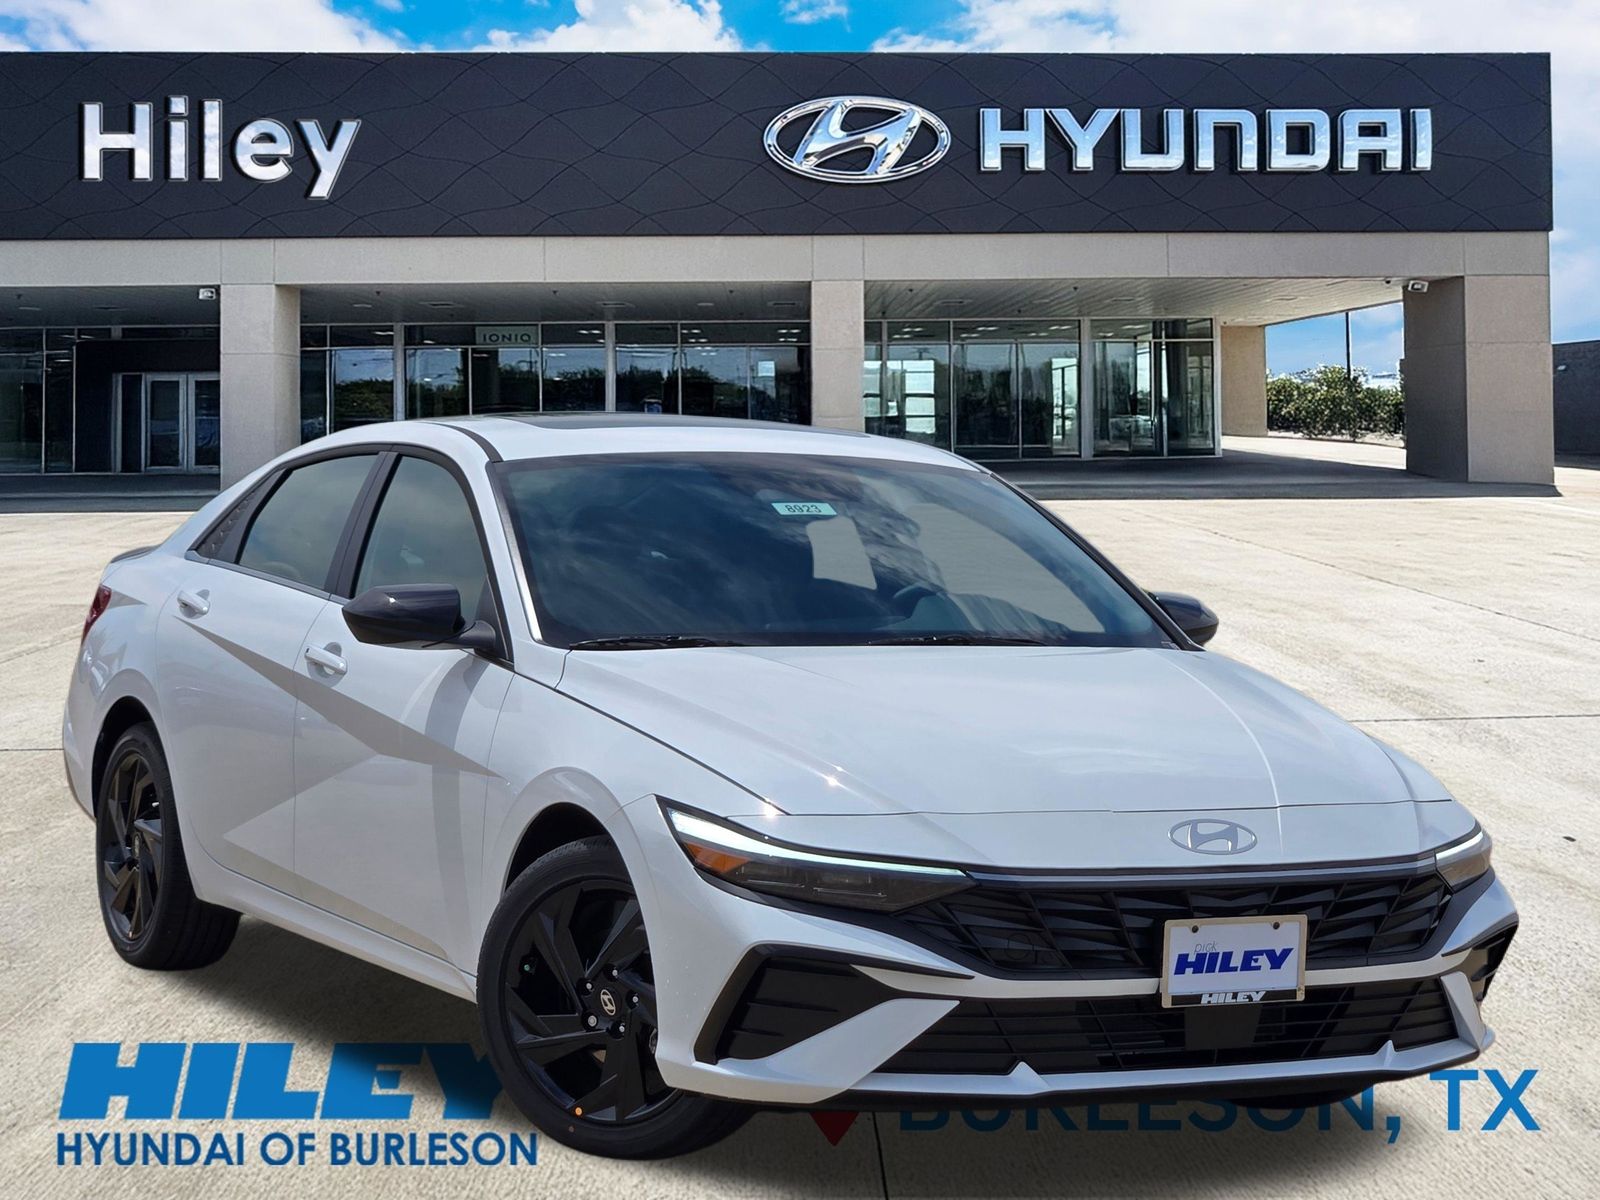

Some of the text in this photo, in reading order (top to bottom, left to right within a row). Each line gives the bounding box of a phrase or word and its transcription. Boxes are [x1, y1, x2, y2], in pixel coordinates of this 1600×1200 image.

[80, 95, 362, 200] Hiley
[979, 107, 1433, 172] HYUNDAI
[483, 333, 531, 343] IONIQ
[1174, 948, 1294, 976] HILEY
[1200, 991, 1266, 1005] HILEY
